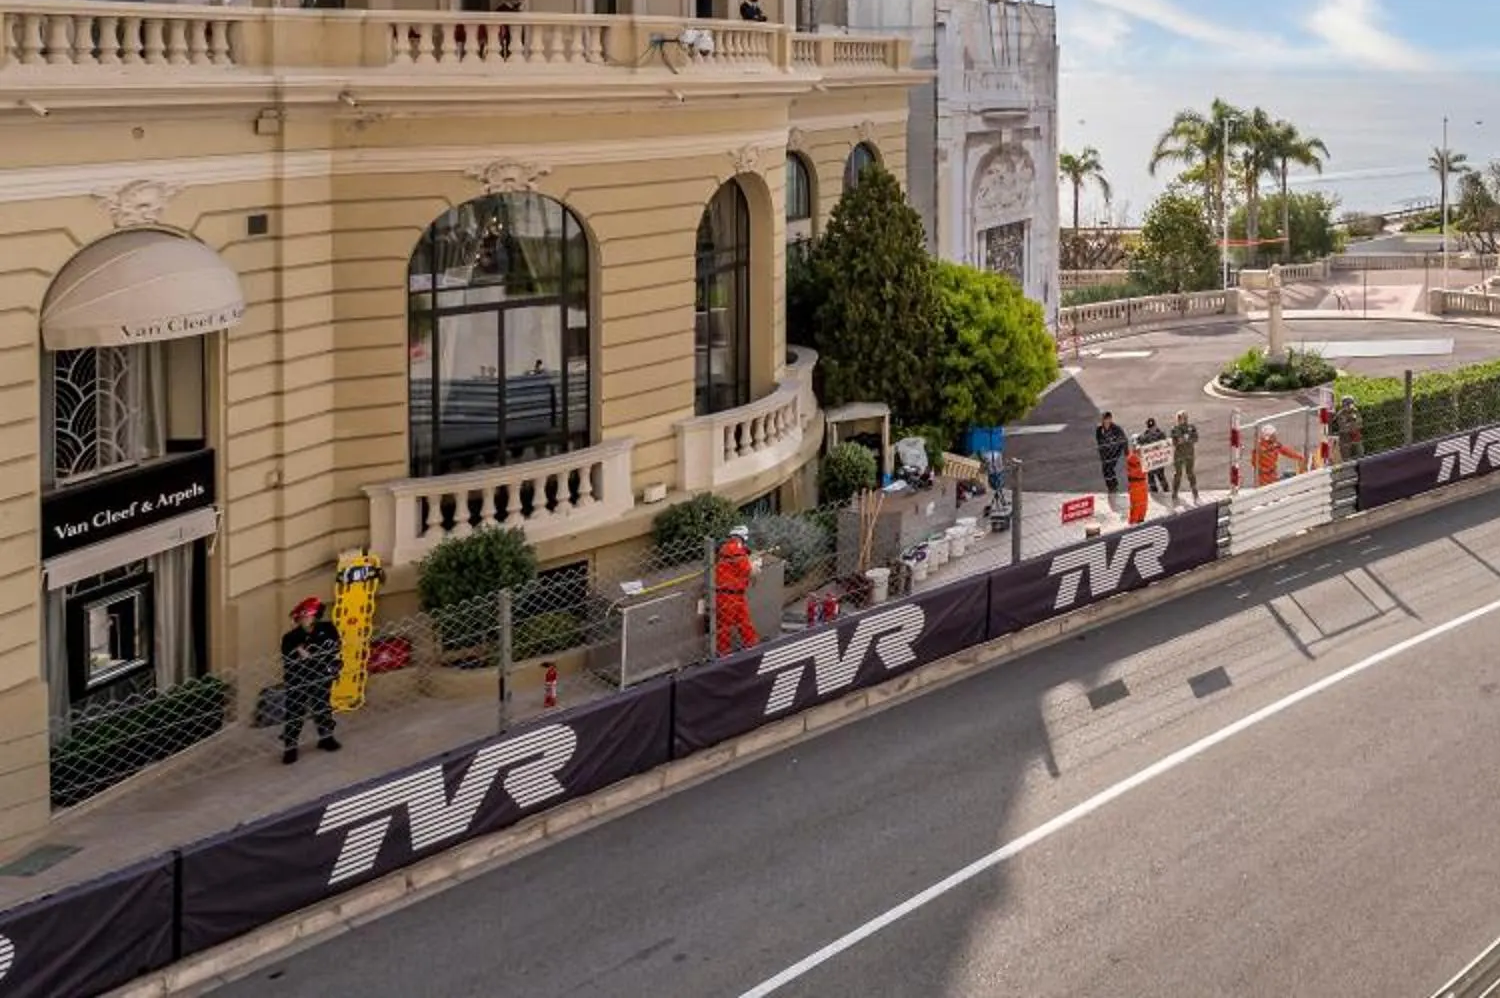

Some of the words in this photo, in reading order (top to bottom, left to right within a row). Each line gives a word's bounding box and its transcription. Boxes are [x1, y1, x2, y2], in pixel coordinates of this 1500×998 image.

[54, 521, 89, 540] Van
[92, 501, 139, 528] Cleef
[141, 501, 153, 513] &
[155, 482, 205, 507] Arpels
[1048, 525, 1169, 610] TVR
[757, 603, 925, 715] TVR
[316, 723, 577, 885] TVR
